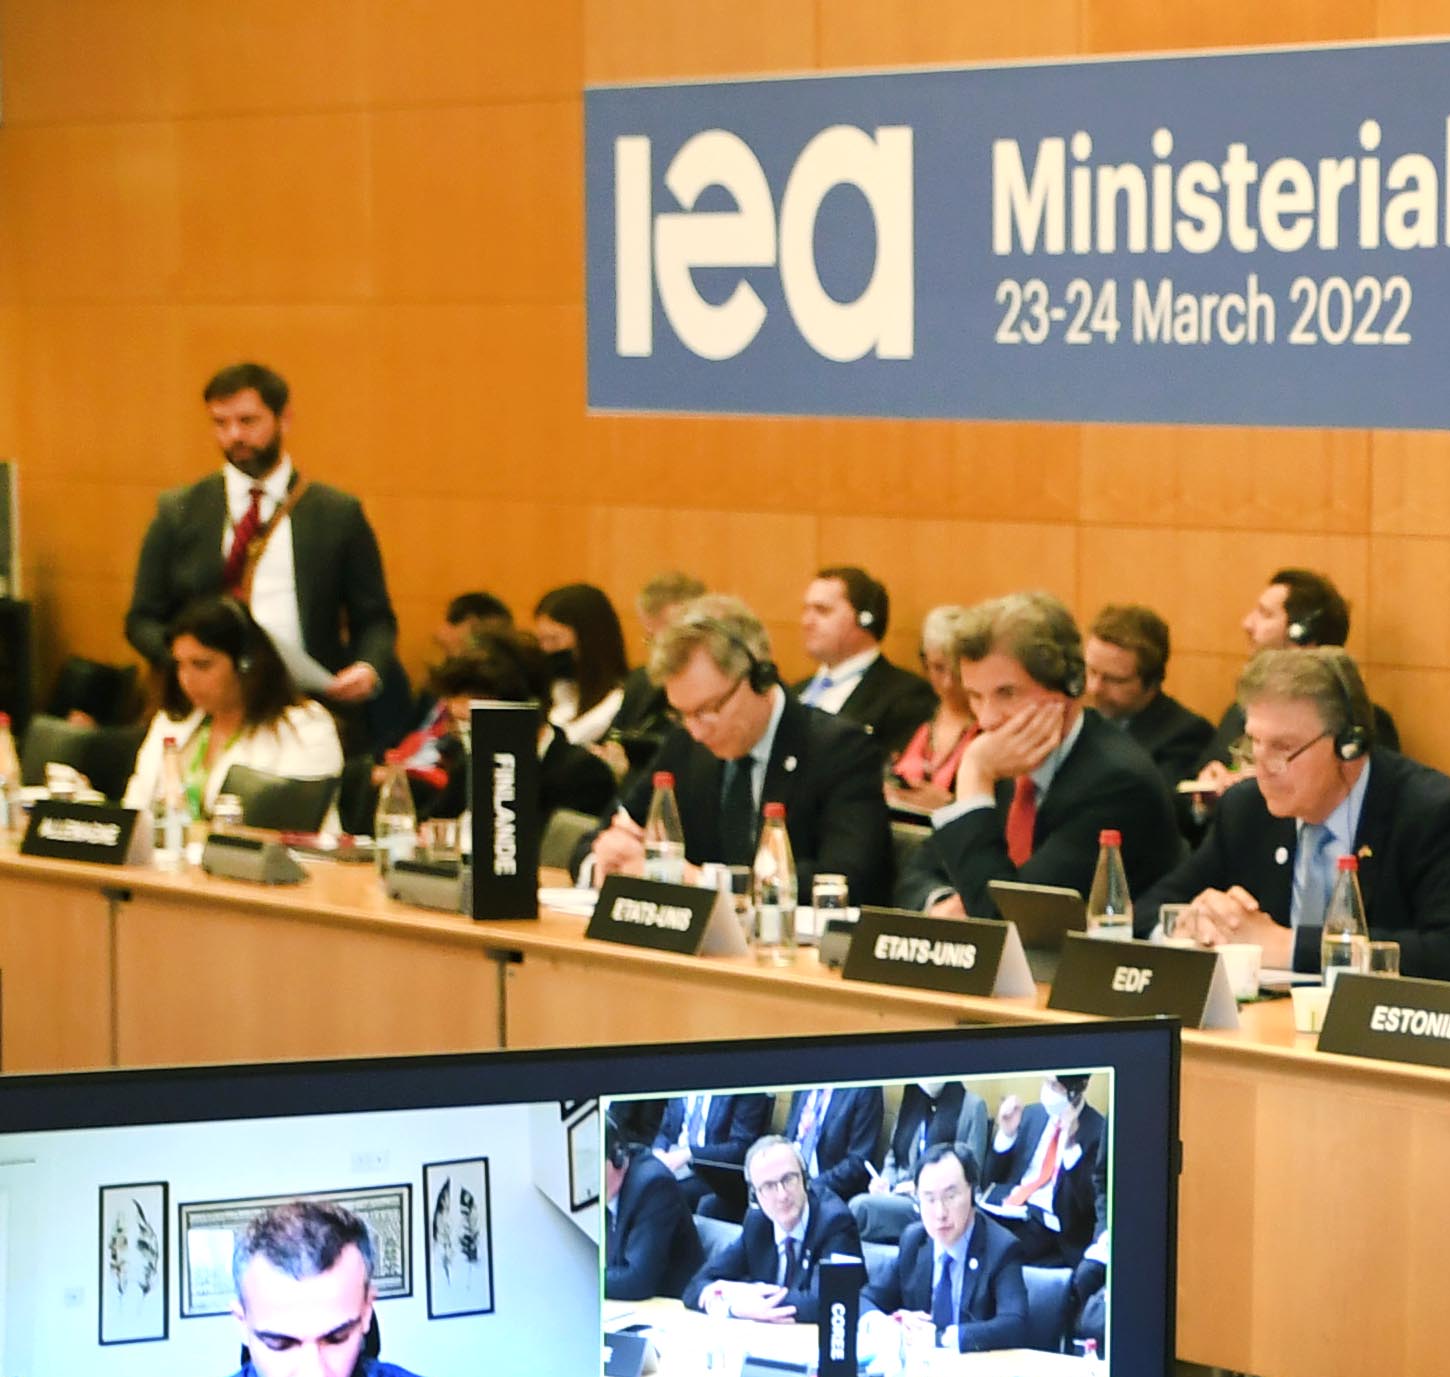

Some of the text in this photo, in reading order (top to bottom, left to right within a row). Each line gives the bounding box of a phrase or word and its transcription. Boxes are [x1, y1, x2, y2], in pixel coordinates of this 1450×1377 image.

[994, 272, 1413, 345] 23-24 March 2022
[610, 896, 694, 933] ETATS-UNIS
[873, 933, 978, 970] ETATS-UNIS
[1111, 965, 1154, 995] EDF
